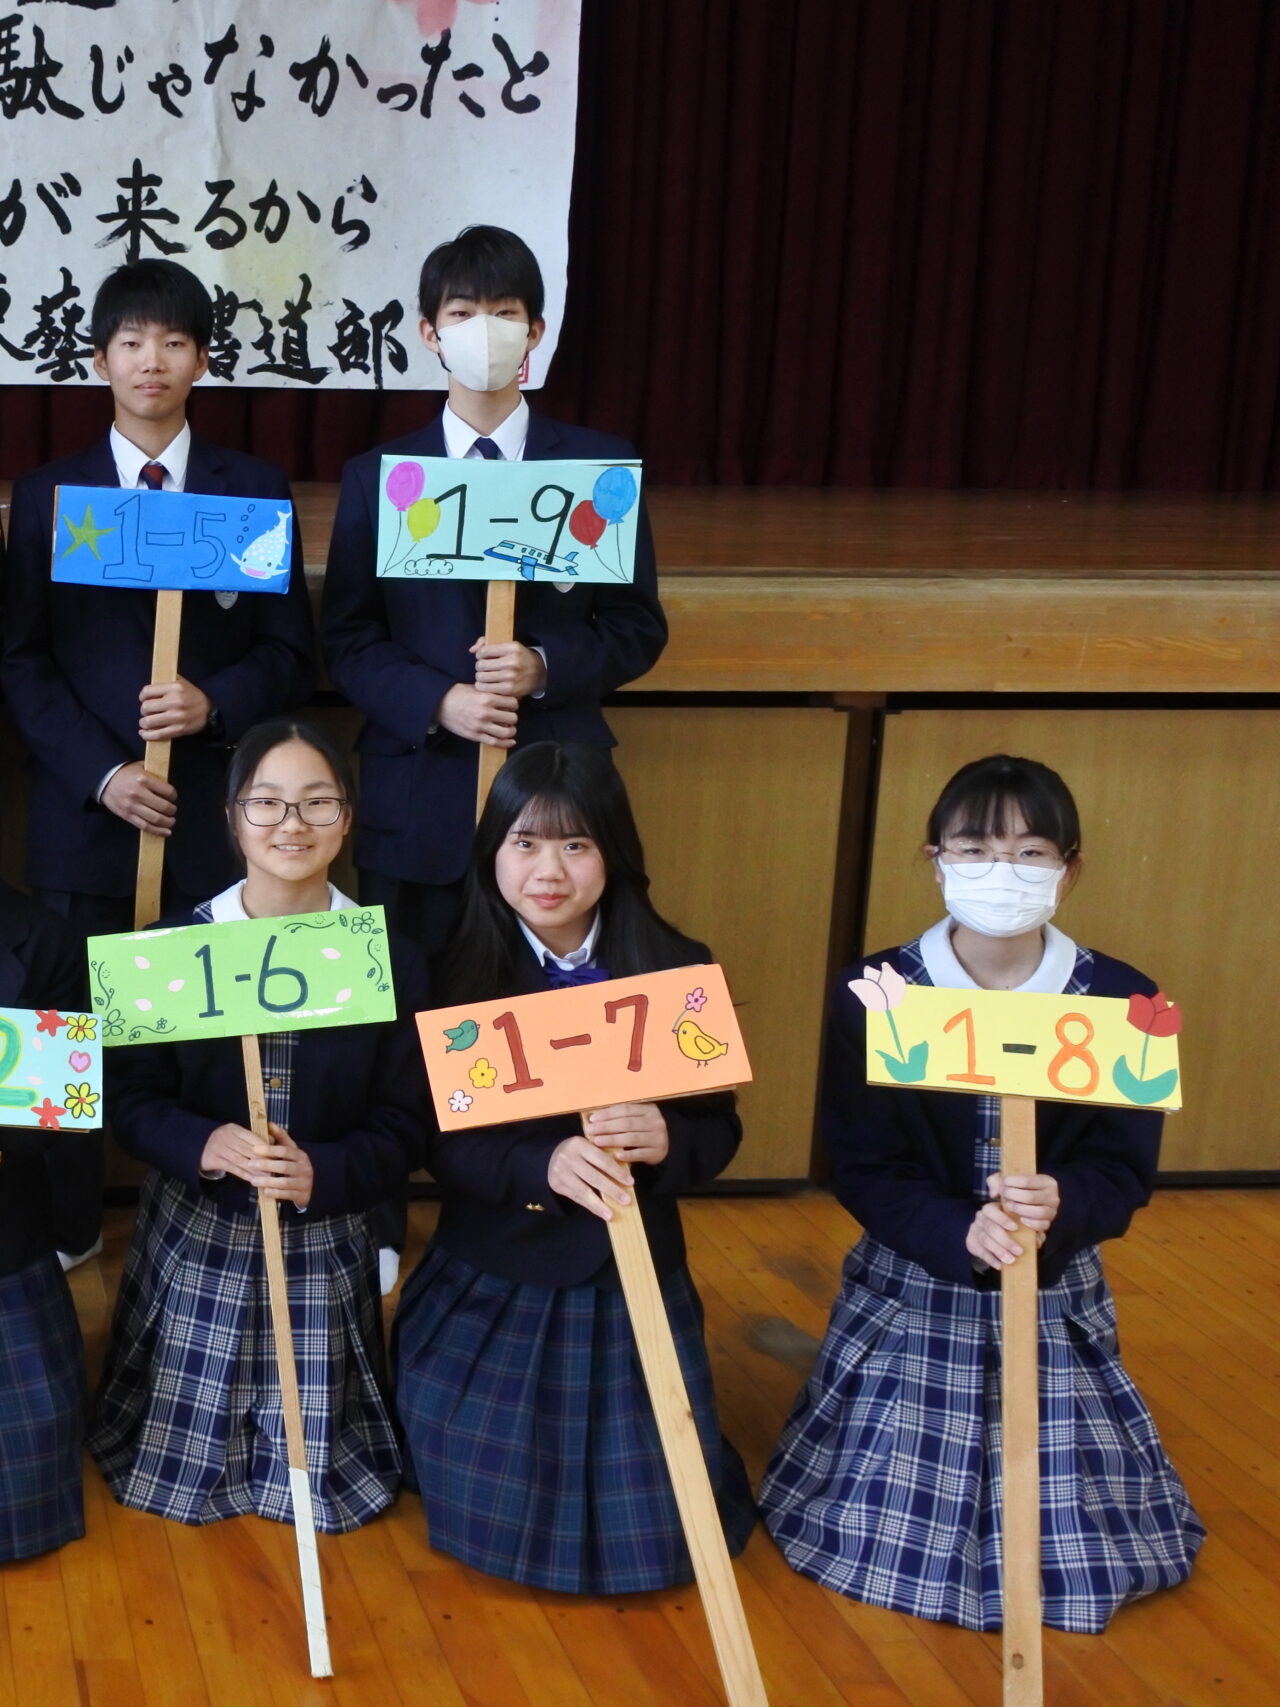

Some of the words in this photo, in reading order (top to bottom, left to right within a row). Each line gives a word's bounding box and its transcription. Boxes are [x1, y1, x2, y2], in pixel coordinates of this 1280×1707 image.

[102, 493, 228, 583] 1-5
[426, 482, 576, 566] 1-9
[193, 934, 309, 1019] 1-6
[491, 993, 650, 1094] 1-7
[942, 1008, 1100, 1097] 1-8
